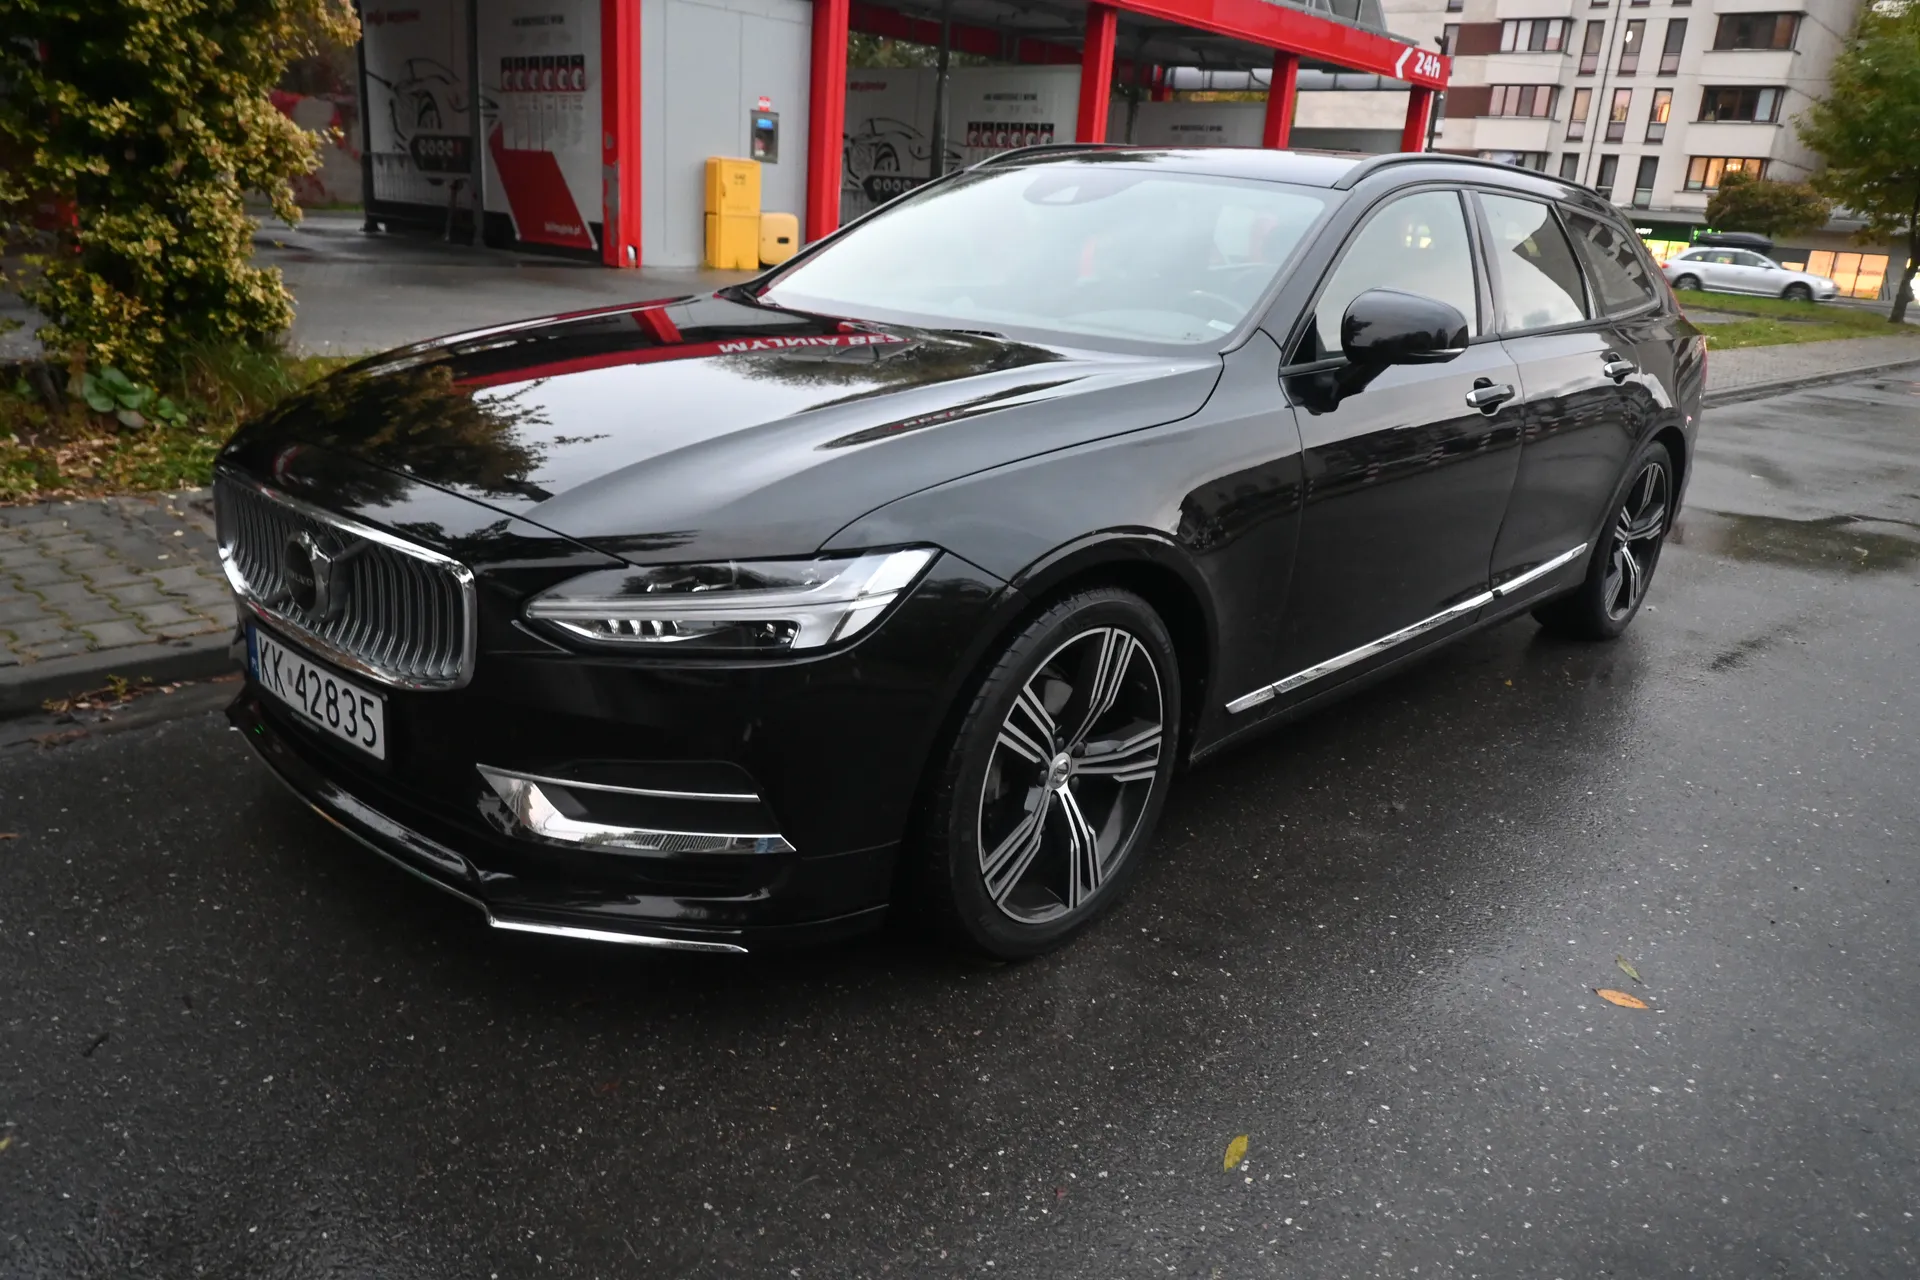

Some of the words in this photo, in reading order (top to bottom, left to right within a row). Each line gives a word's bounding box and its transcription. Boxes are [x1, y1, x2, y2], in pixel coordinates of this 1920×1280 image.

[1414, 51, 1441, 79] 24h
[258, 636, 287, 698] KK
[295, 663, 377, 748] 42835
